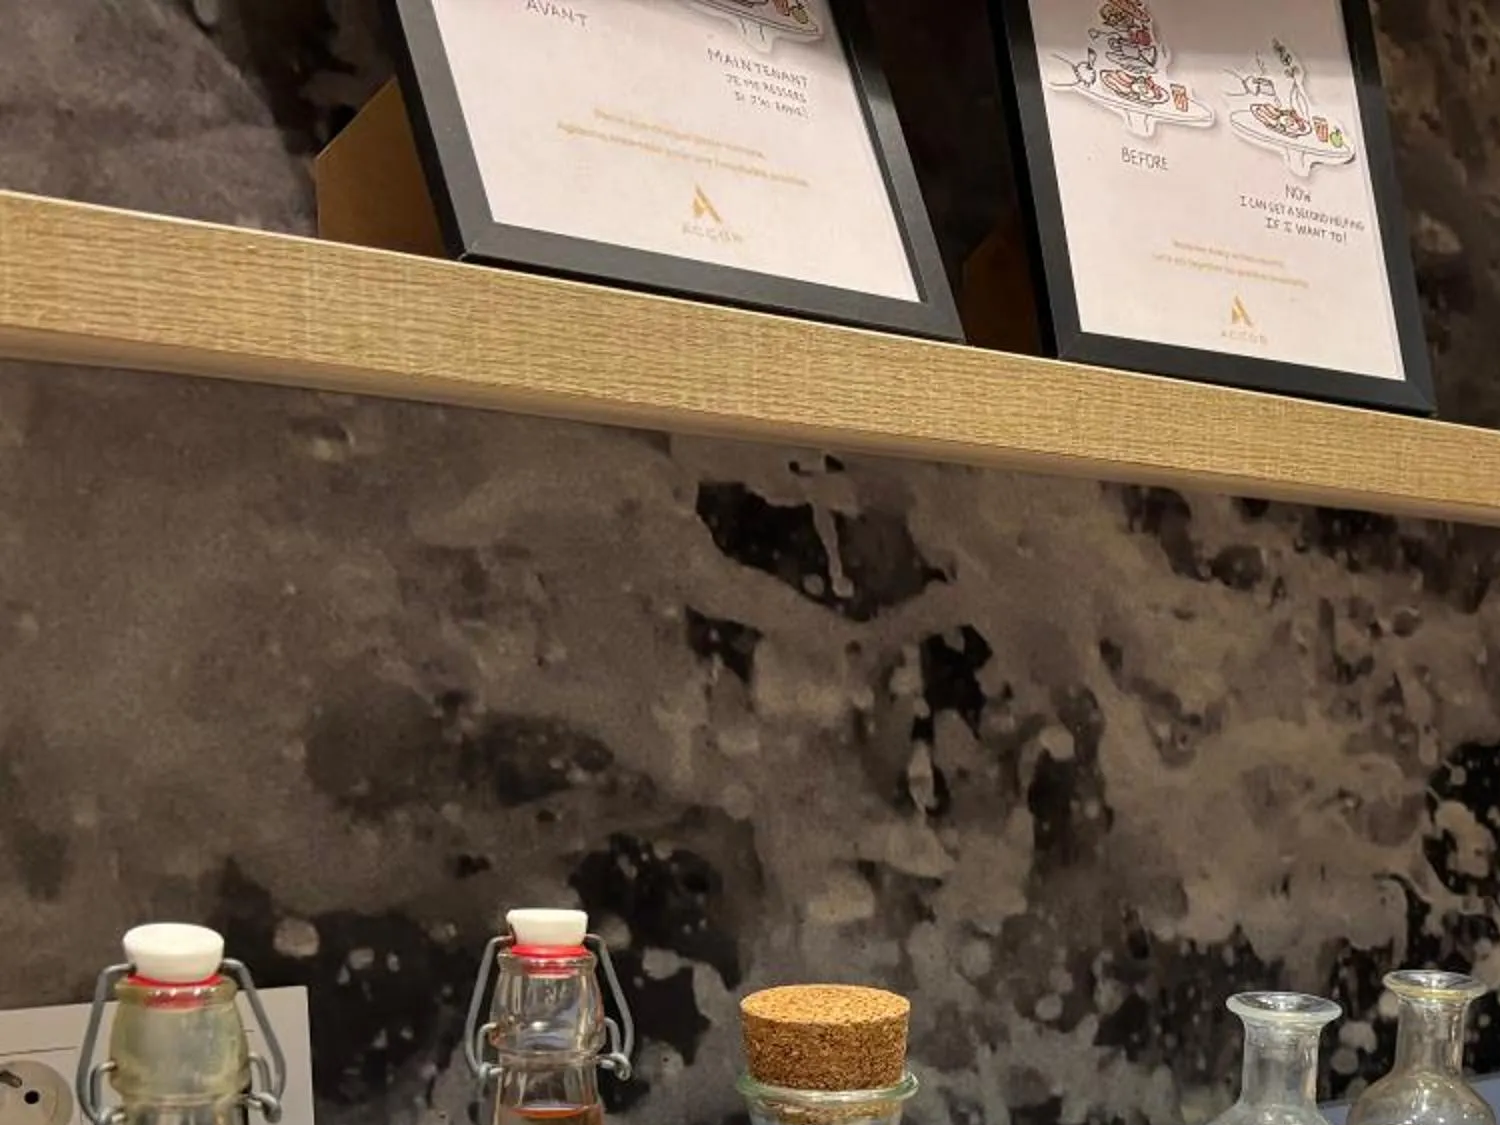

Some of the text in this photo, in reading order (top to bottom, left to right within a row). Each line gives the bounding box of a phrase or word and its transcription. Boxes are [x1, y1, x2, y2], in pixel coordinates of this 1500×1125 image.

[526, 0, 588, 27] AVANT
[706, 47, 808, 88] MAINTENANT
[1121, 146, 1169, 171] BEFORE
[1285, 183, 1311, 203] NOW
[1239, 194, 1247, 207] I
[1247, 197, 1267, 210] CAN
[1268, 201, 1286, 216] GET
[1286, 206, 1296, 217] A
[1265, 216, 1281, 229] IF
[1283, 220, 1293, 234] I
[1295, 223, 1329, 240] WANT
